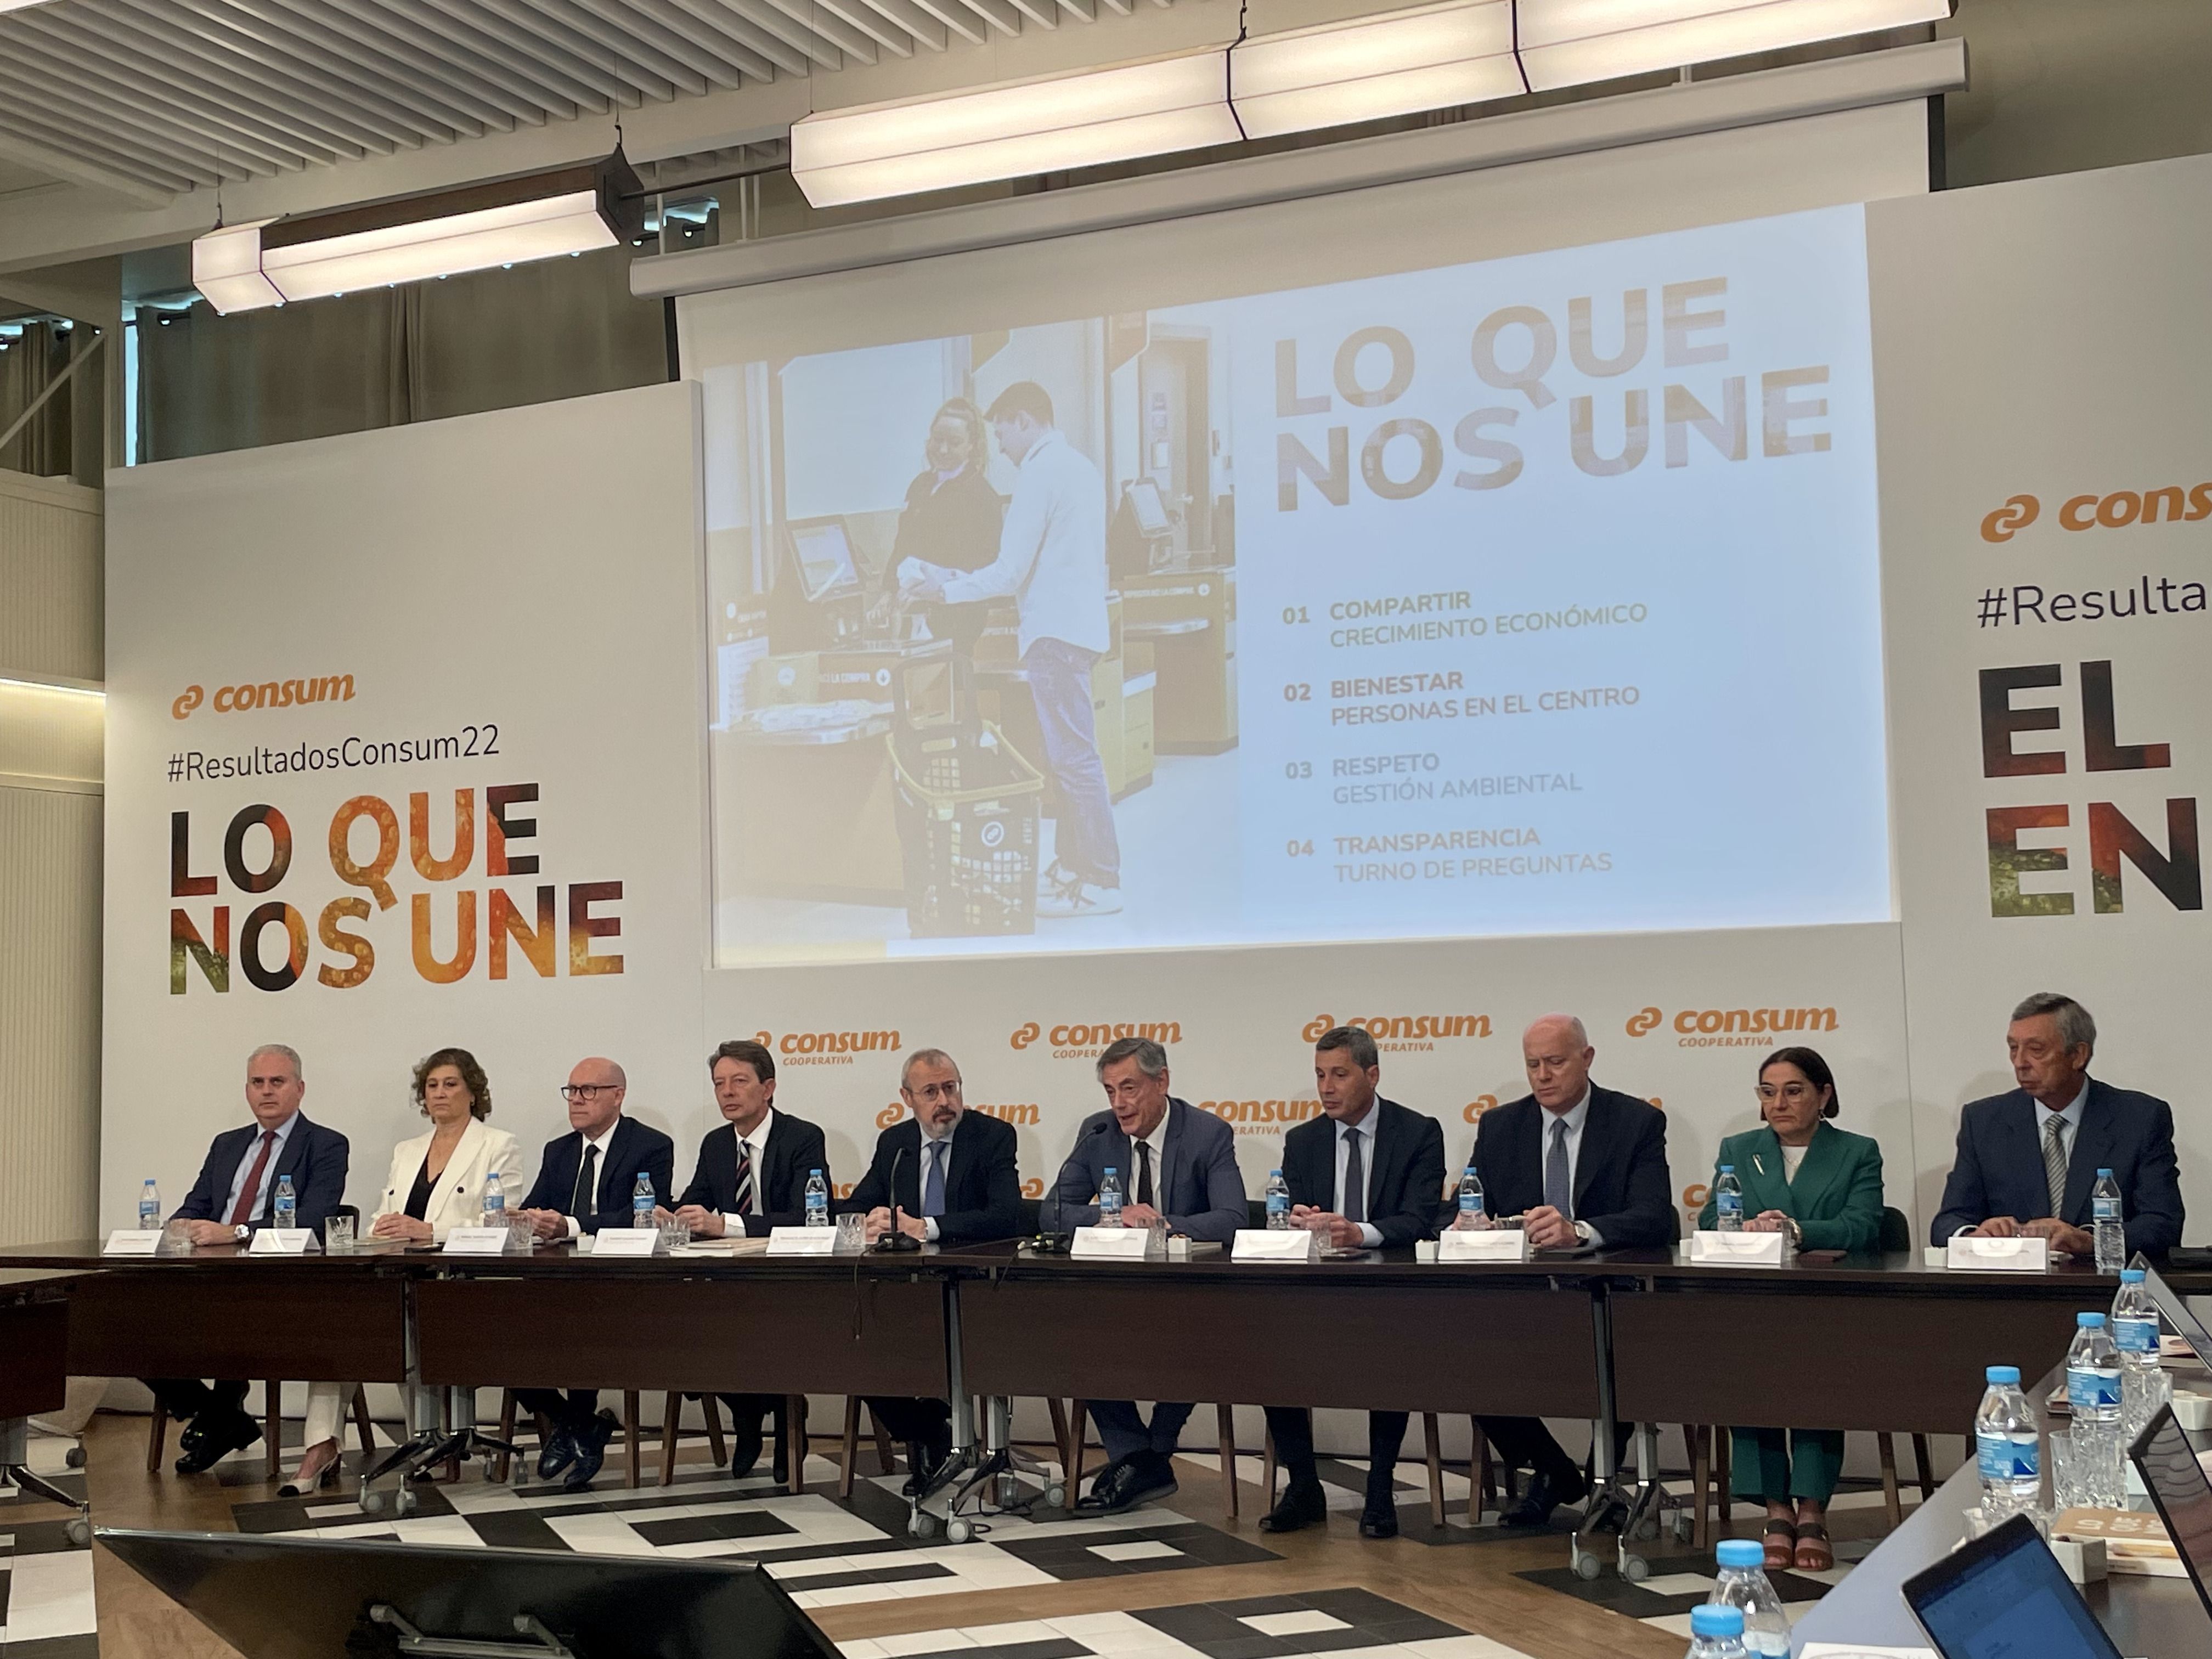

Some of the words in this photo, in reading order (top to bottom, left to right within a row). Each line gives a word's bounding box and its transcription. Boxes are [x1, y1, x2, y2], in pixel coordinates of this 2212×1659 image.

[1275, 325, 1415, 417] LO
[1471, 276, 1730, 411] QUE
[1276, 407, 1525, 512] NOS
[1569, 365, 1831, 477] UNE
[1282, 606, 1311, 625] 01
[1329, 591, 1471, 620] COMPARTIR
[1977, 575, 2207, 628] #Resulta
[1330, 618, 1488, 648] CRECIMIENTO
[1495, 603, 1647, 634] ECONÓMICO
[213, 673, 356, 713] consum
[1284, 683, 1311, 702] 02
[1331, 671, 1464, 698] BIENESTAR
[1331, 699, 1459, 726] PERSONAS
[1464, 697, 1496, 717] EN
[1504, 695, 1531, 714] EL
[1538, 686, 1640, 711] CENTRO
[1979, 659, 2171, 778] EL
[168, 724, 500, 782] #ResultadosConsum22
[1285, 761, 1313, 779] 03
[1333, 753, 1440, 776] RESPETO
[1333, 777, 1434, 804] GESTIÓN
[1441, 772, 1583, 799] AMBIENTAL
[171, 803, 292, 898] LO
[329, 782, 539, 911] QUE
[1286, 839, 1314, 857] 04
[1334, 828, 1541, 855] TRANSPARENCIA
[1985, 797, 2203, 918] EN
[1334, 861, 1417, 883] TURNO
[1423, 860, 1455, 879] DE
[1462, 853, 1612, 878] PREGUNTAS
[170, 896, 375, 995] NOS
[411, 881, 624, 984] UNE
[1673, 1007, 1839, 1034] consum
[780, 1030, 902, 1053] consum
[782, 1056, 854, 1066] COOPERATIVA
[1678, 1036, 1774, 1047] COOPERATIVA
